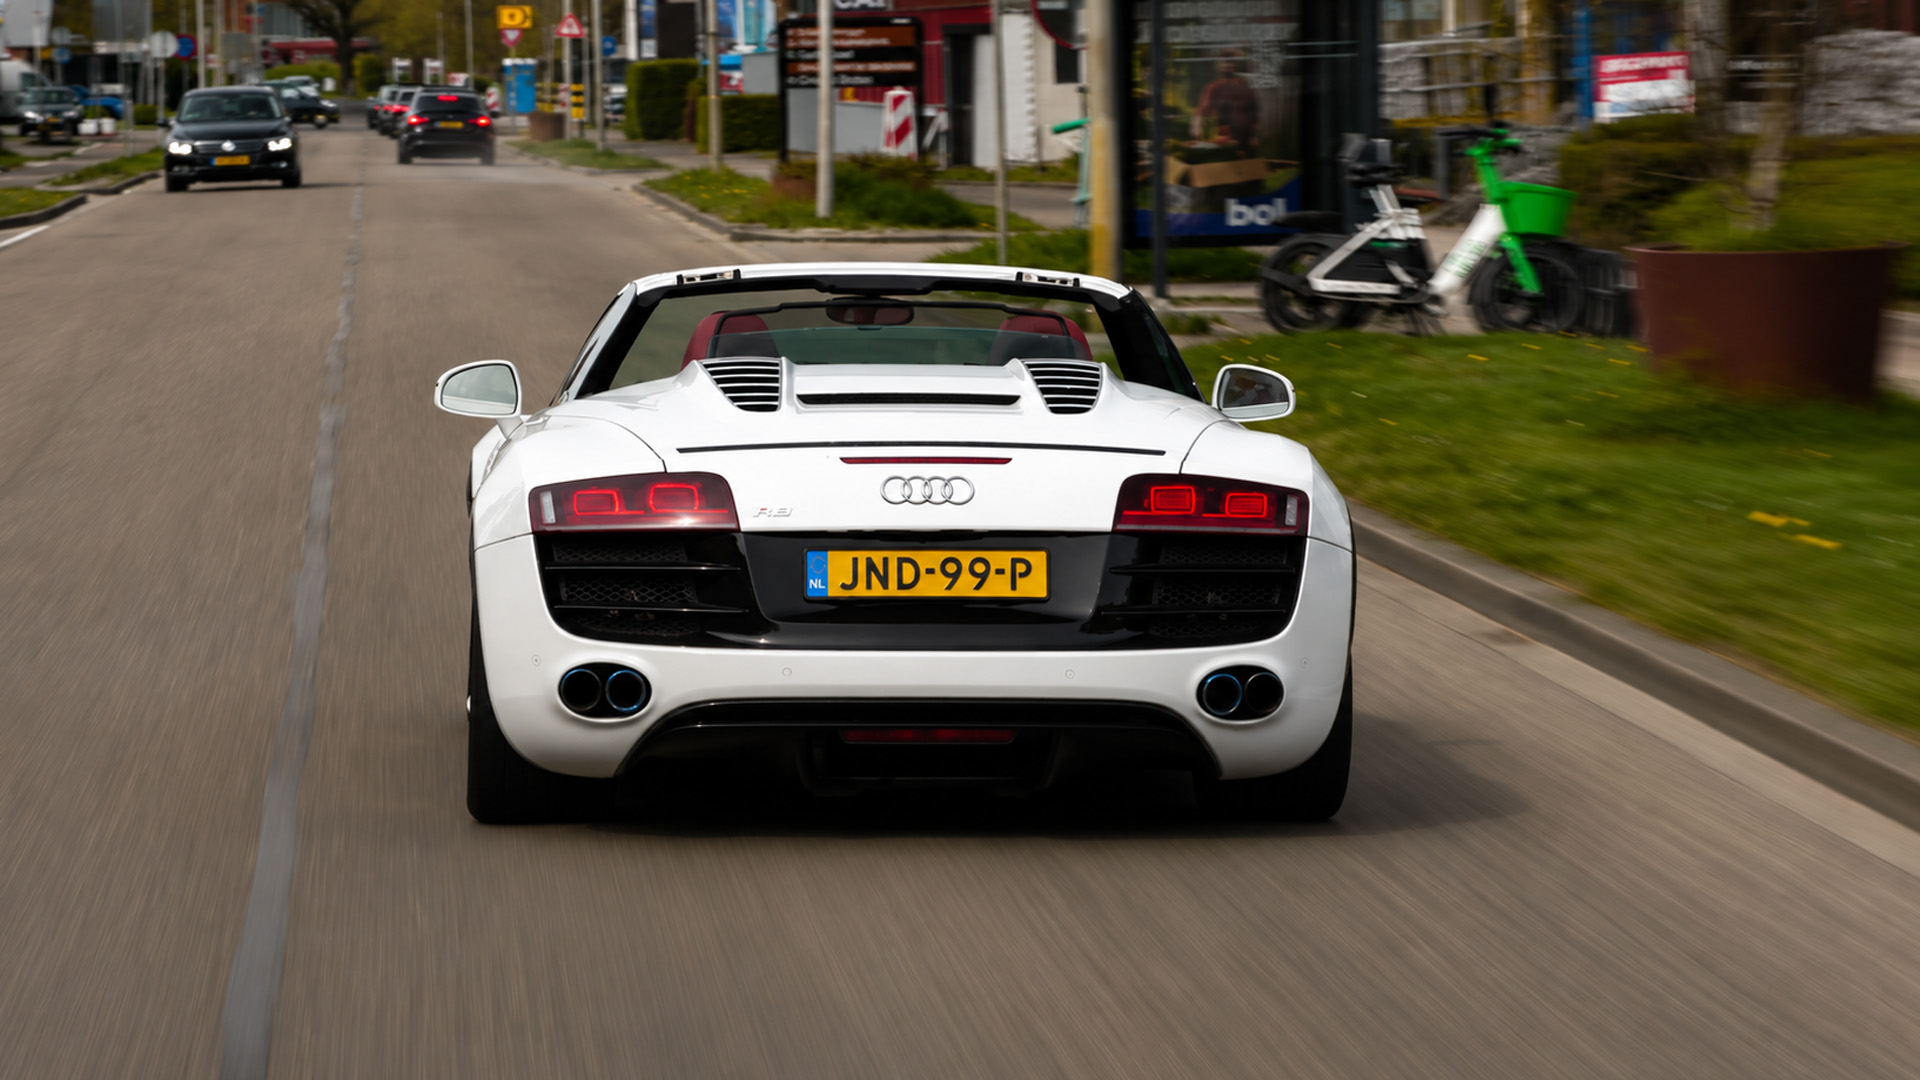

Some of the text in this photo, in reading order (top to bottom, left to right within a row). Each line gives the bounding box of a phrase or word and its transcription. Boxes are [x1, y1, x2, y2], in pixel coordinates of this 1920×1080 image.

[1224, 197, 1288, 227] bol
[753, 506, 793, 518] R8
[839, 556, 1033, 591] JND-99-P
[809, 579, 826, 590] NL
